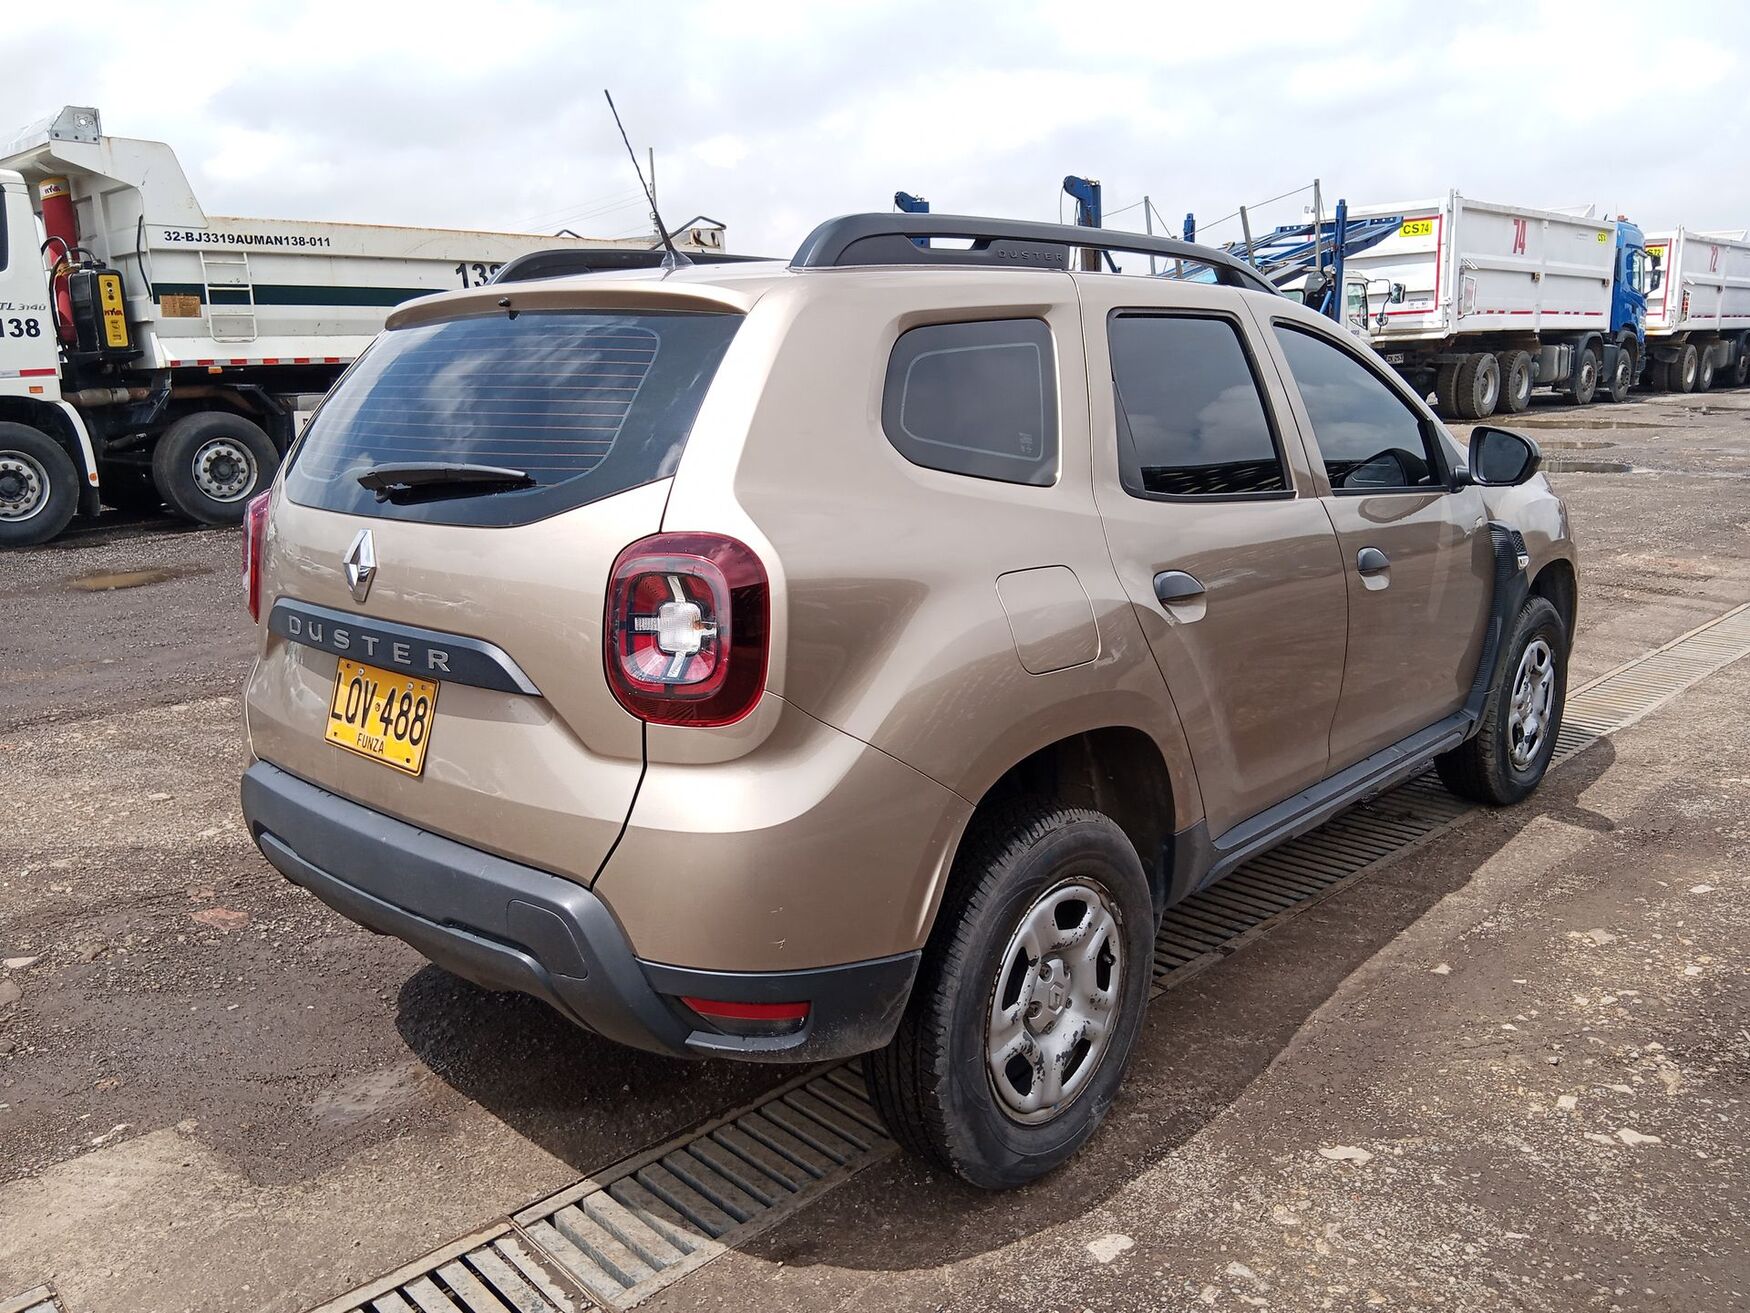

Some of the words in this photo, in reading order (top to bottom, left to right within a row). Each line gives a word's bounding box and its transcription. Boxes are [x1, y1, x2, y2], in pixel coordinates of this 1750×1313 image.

[1403, 224, 1419, 234] CS
[1420, 223, 1430, 233] 74
[1513, 218, 1527, 255] 74
[164, 231, 331, 247] 32-BJ3319AUMAN138-011
[998, 249, 1063, 261] DUSTER
[18, 303, 46, 311] 3140
[288, 614, 451, 673] DUSTER
[357, 732, 385, 755] FUNZA
